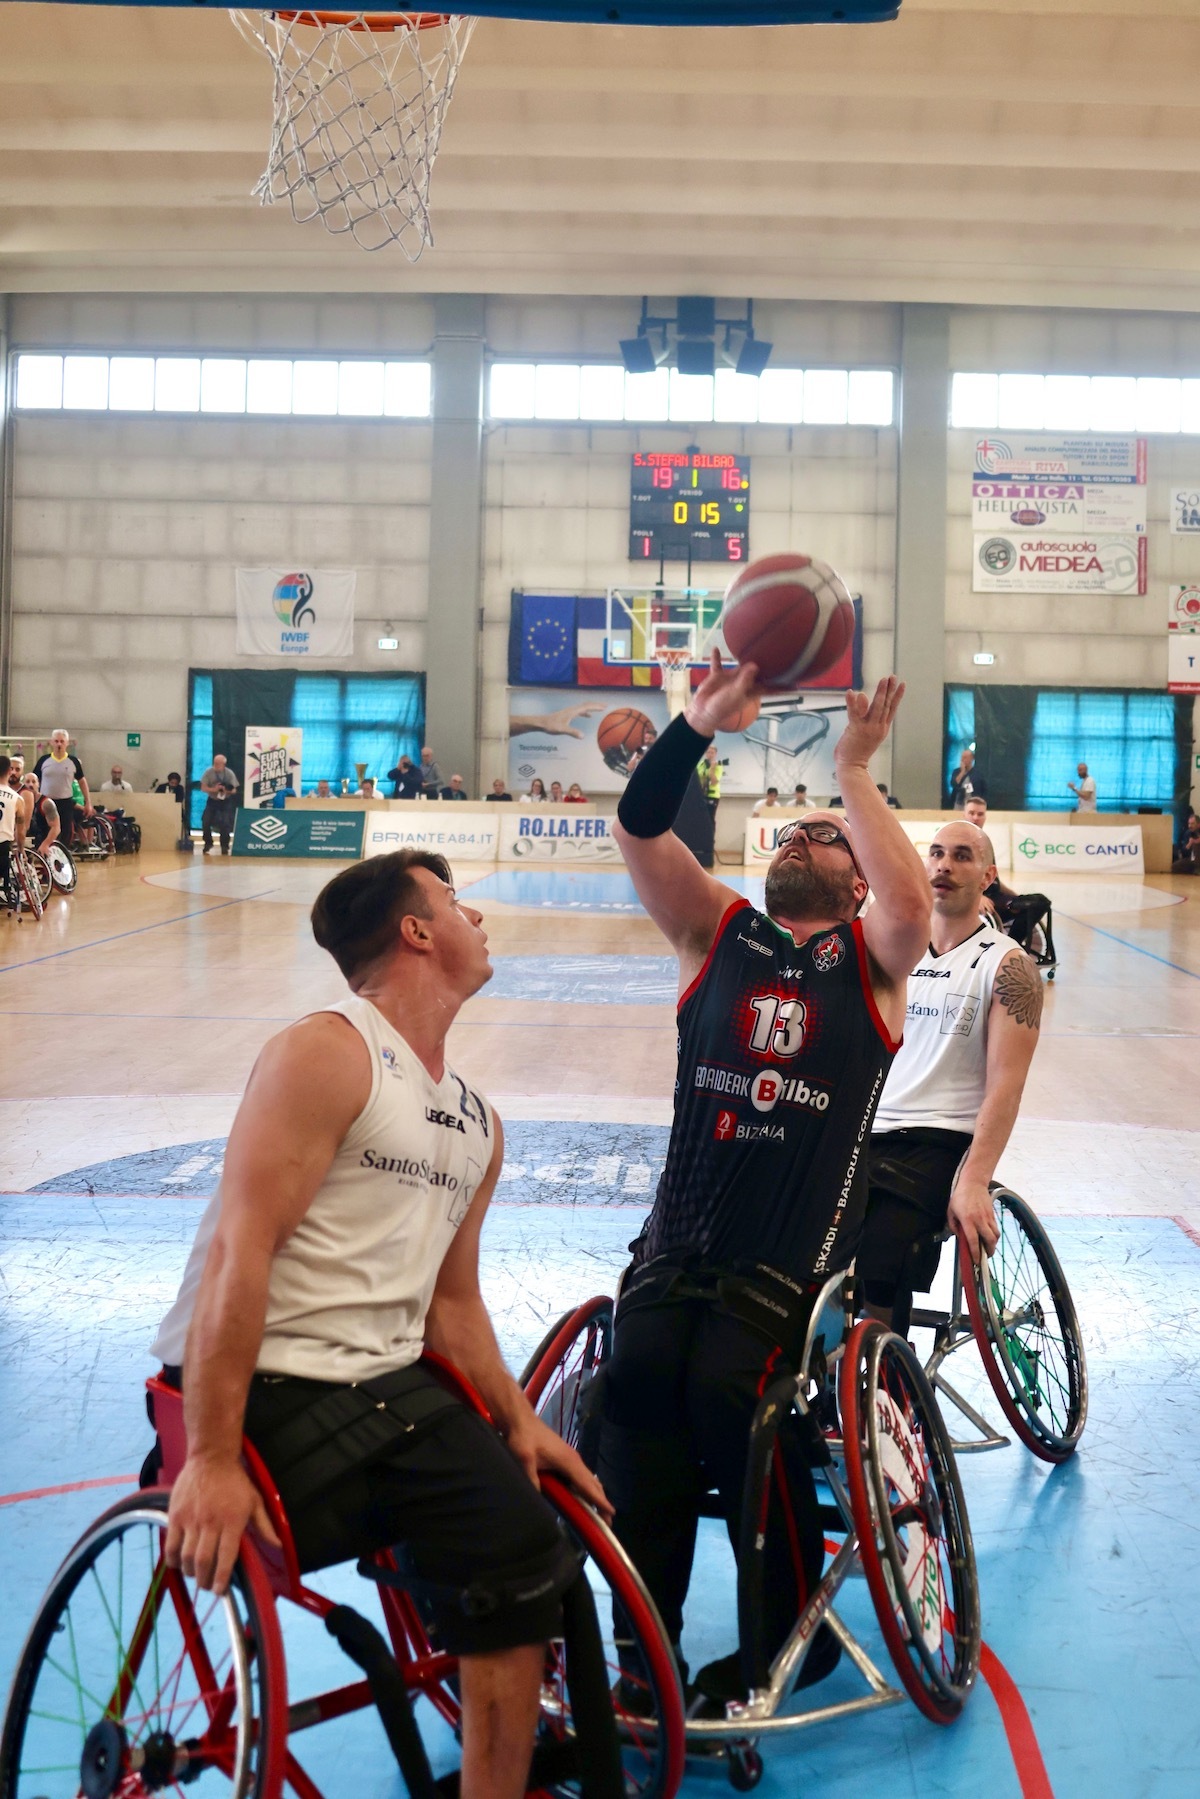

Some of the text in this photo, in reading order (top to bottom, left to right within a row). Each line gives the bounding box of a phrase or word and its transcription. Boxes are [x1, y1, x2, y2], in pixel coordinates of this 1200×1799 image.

[633, 453, 735, 468] S.STEFAN BILBAO
[1036, 462, 1065, 472] RIVA
[652, 467, 740, 490] 19 1 16
[976, 485, 1081, 499] OTTICA
[673, 501, 720, 525] 0 15
[978, 500, 1029, 513] HELLO
[1033, 501, 1078, 514] VISTA
[643, 537, 650, 557] 1
[727, 538, 742, 560] 5
[1020, 540, 1097, 553] autoscuola
[987, 550, 1009, 564] 50
[1019, 556, 1104, 574] MEDEA
[281, 632, 310, 643] IWBF
[280, 644, 309, 653] Europe
[518, 744, 558, 753] Tecnologia
[261, 749, 286, 763] EURO
[261, 761, 279, 772] CUP
[260, 768, 287, 781] FINAL
[260, 777, 287, 790] 28 30
[518, 818, 611, 838] RO.LA.FER.
[372, 832, 493, 845] BRIANTEA84.IT
[1045, 841, 1138, 856] BCC CANTÙ
[909, 969, 951, 979] LEGEA
[749, 993, 807, 1059] 13
[425, 1106, 467, 1134] LEGEA
[735, 1125, 785, 1141] BIZAIA
[837, 1067, 883, 1208] BASQUE COUNTRY
